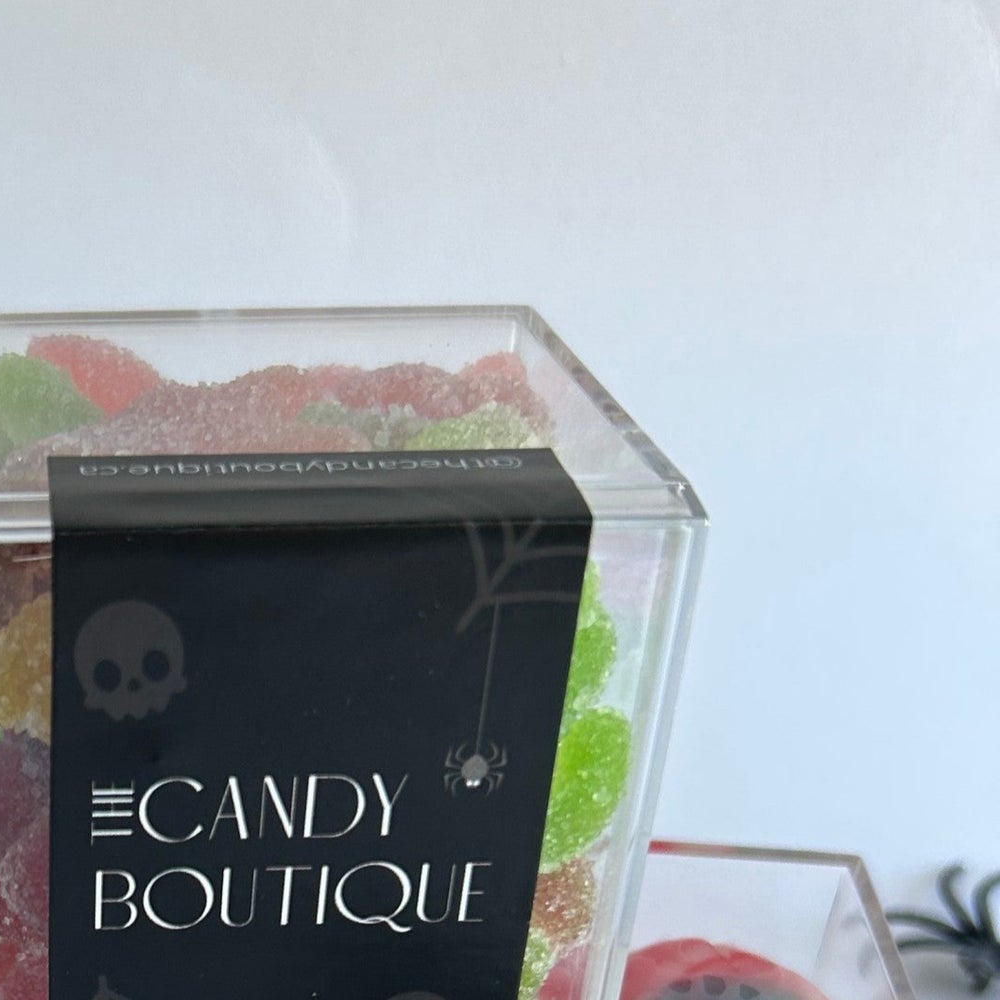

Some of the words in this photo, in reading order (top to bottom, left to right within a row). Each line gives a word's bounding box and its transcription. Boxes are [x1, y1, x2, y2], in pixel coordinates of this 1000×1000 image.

[78, 456, 524, 478] @thecandyboutique.ca
[89, 779, 136, 847] THE
[138, 772, 409, 844] CANDY
[93, 860, 493, 933] BOUTIQUE
